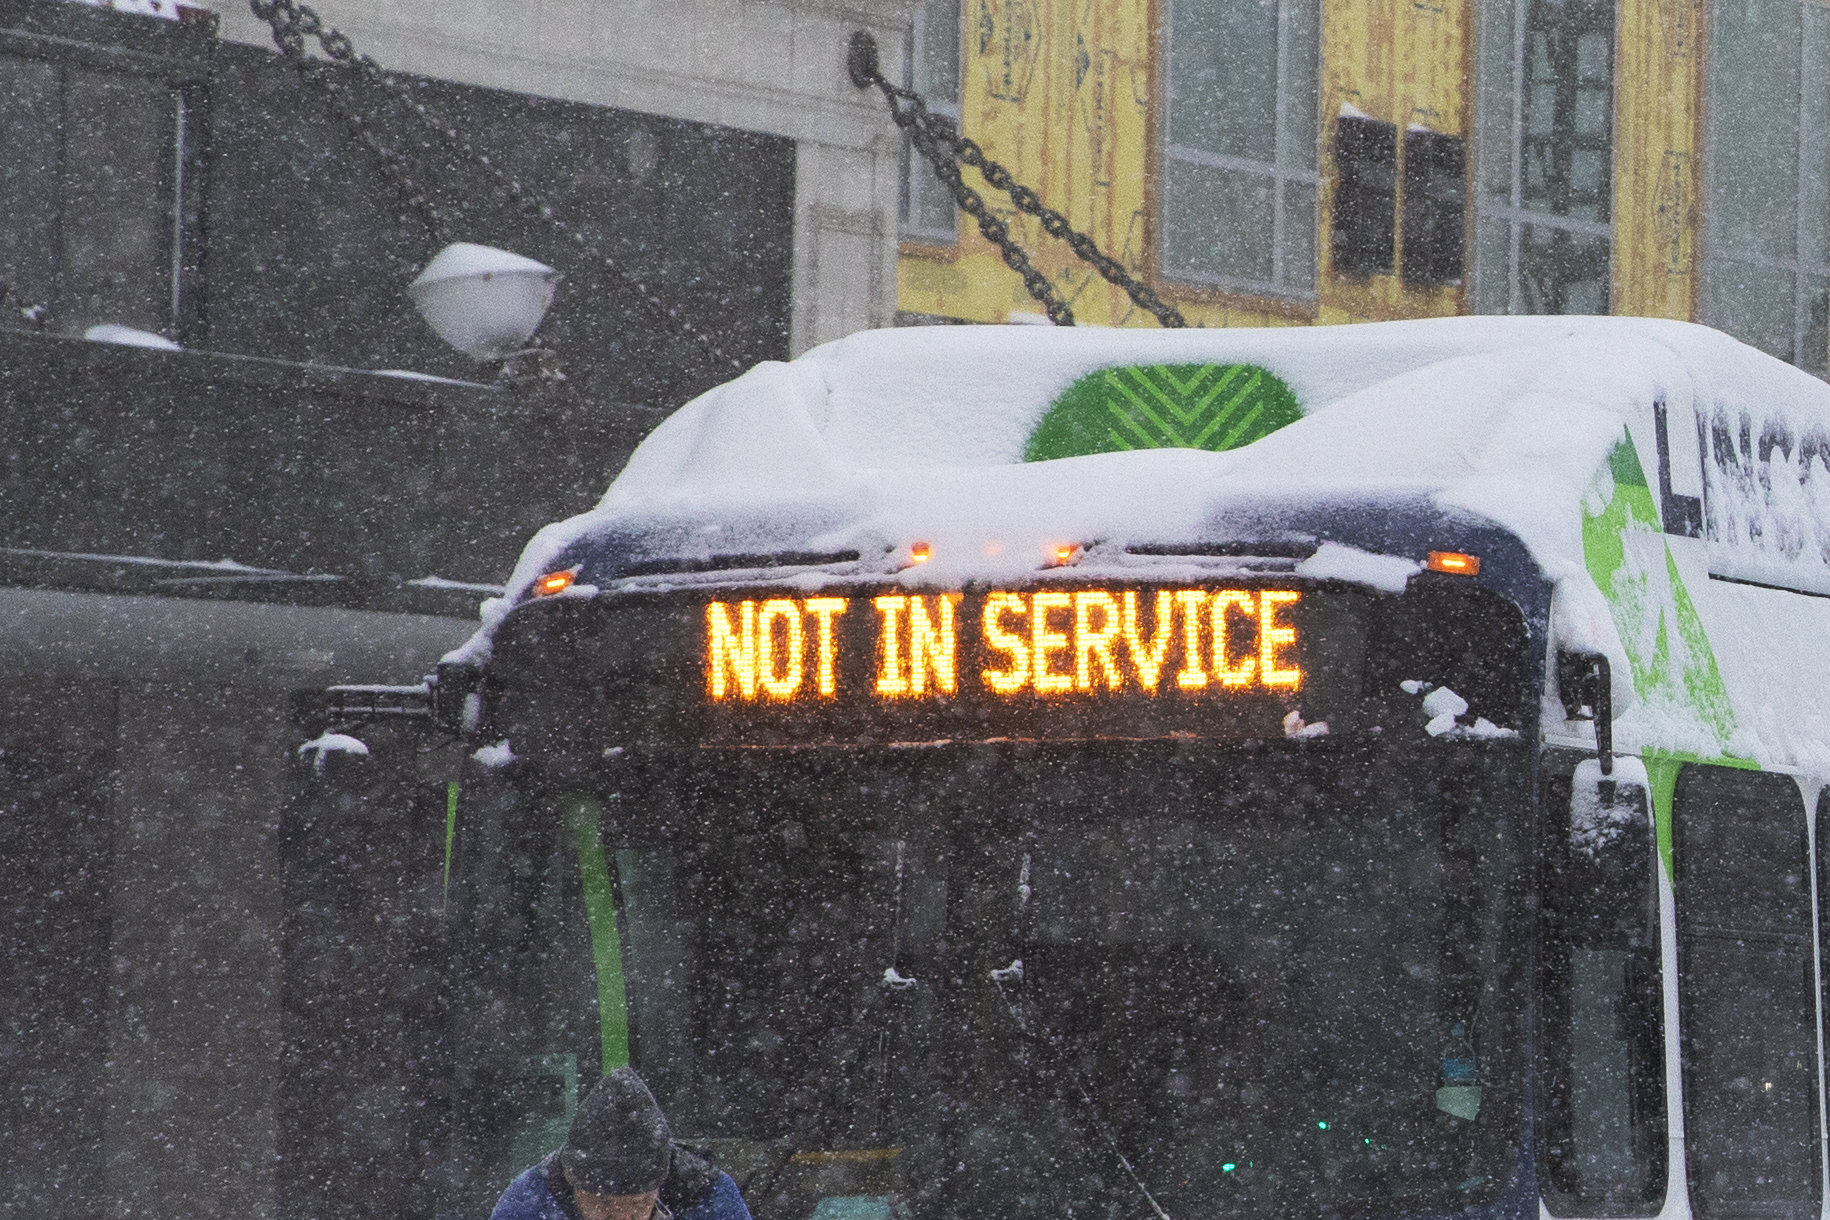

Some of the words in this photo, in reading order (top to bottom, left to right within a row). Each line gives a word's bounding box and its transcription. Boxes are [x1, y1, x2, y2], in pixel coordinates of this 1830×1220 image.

[705, 597, 850, 697] NOT
[874, 594, 958, 694] IN
[982, 590, 1301, 692] SERVICE
